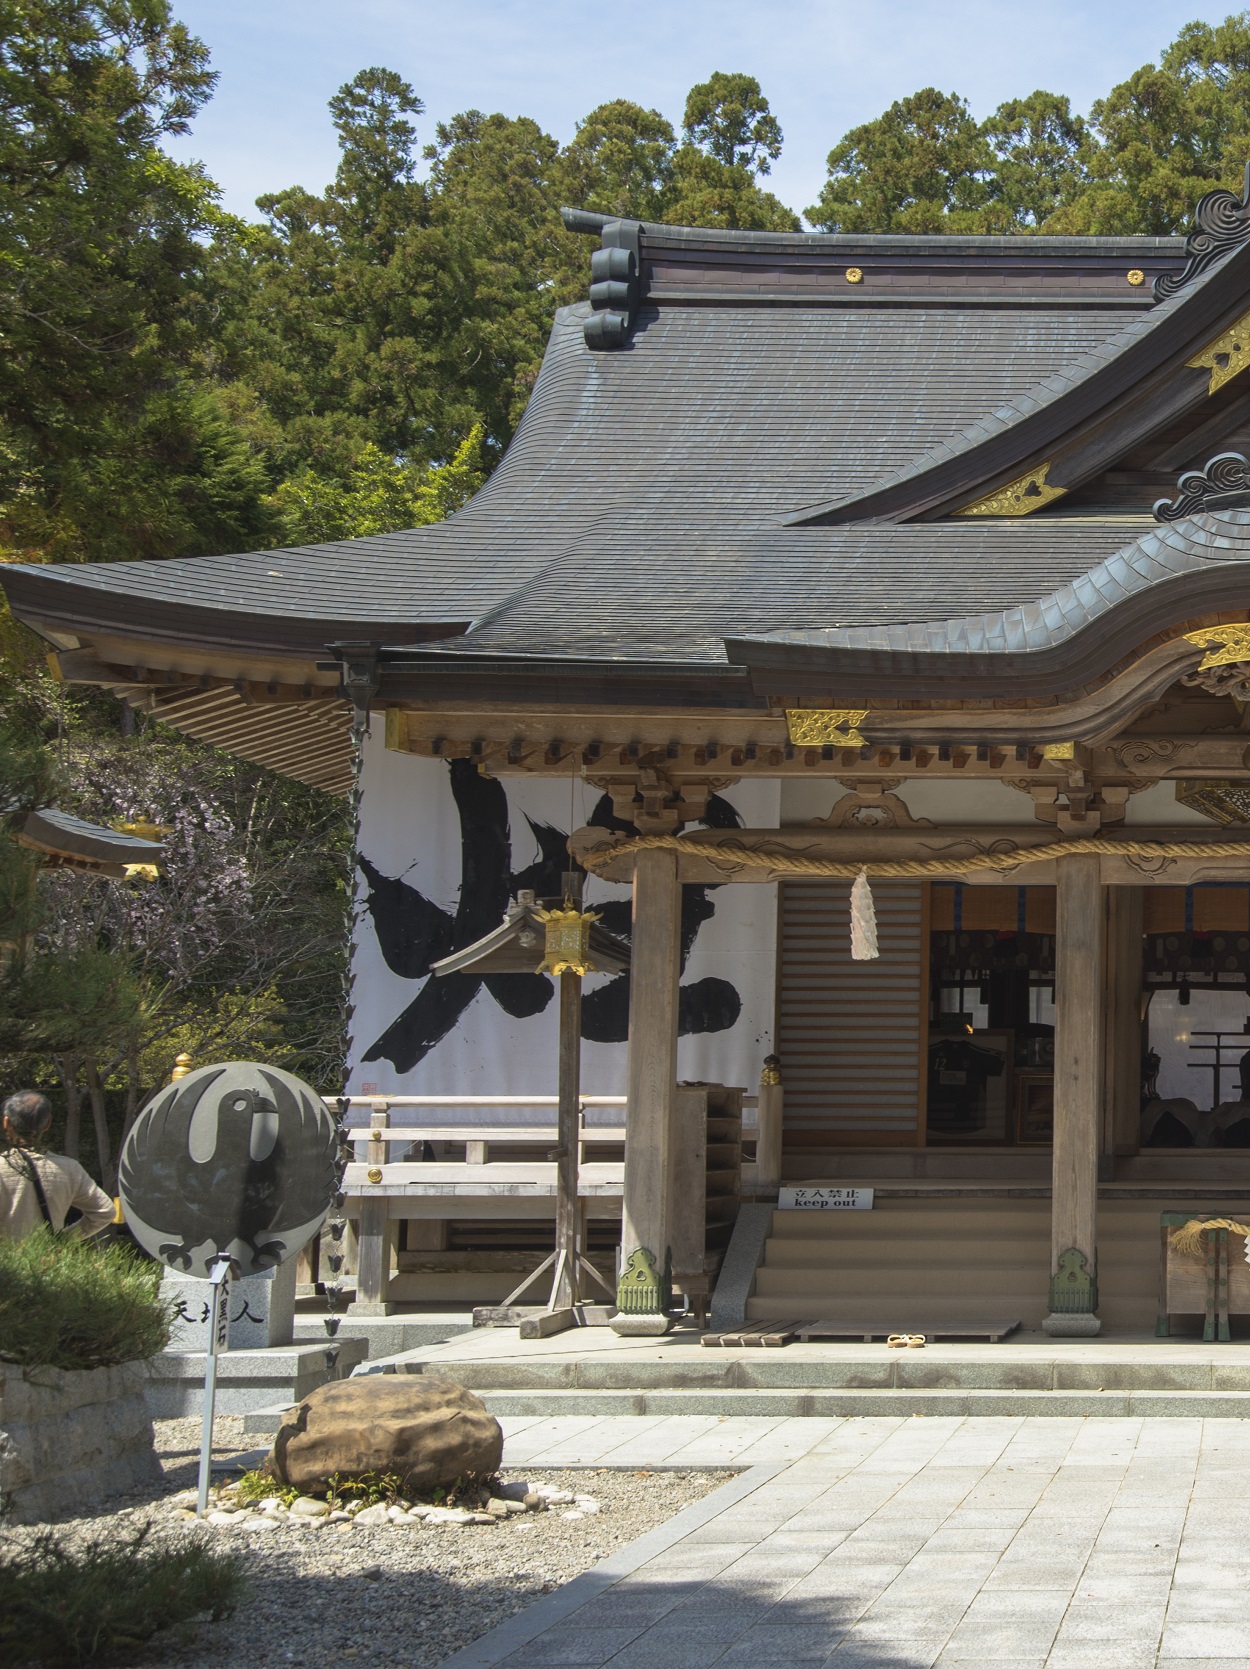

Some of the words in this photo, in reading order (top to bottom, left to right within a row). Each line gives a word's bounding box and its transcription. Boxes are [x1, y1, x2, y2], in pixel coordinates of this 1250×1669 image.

[934, 1058, 947, 1071] 12
[793, 1189, 860, 1199] 立入禁止
[794, 1198, 829, 1208] keep
